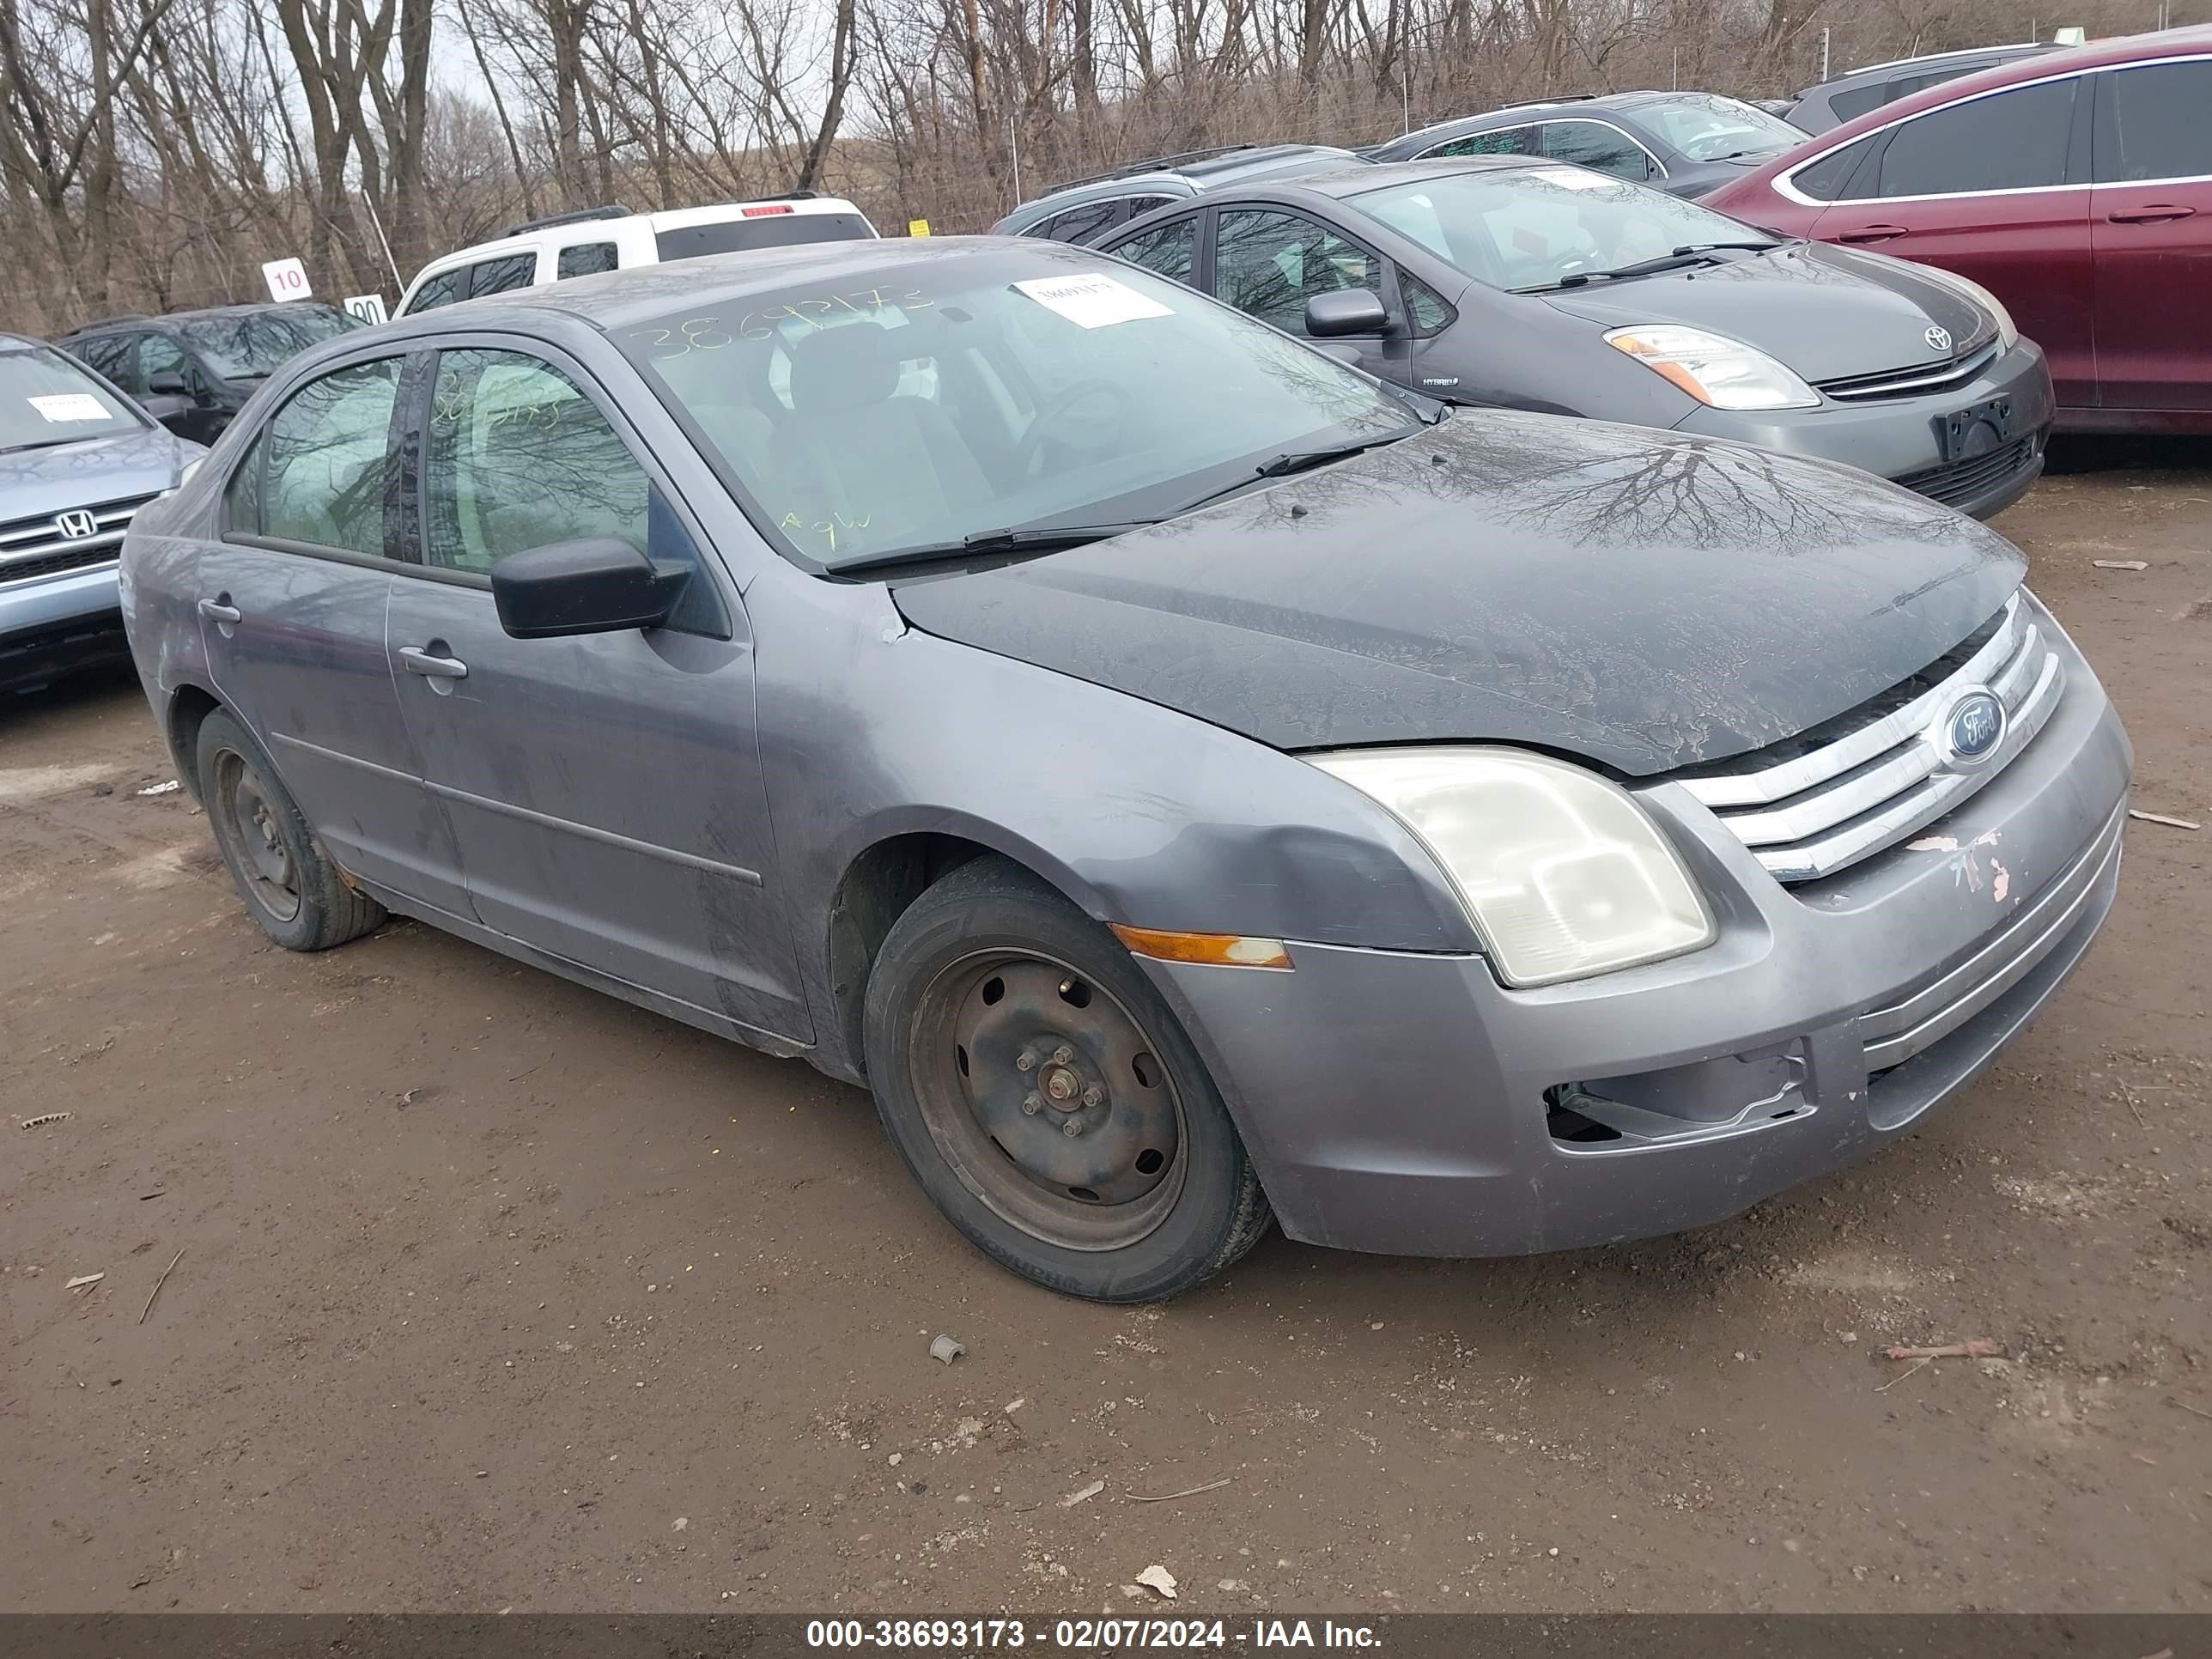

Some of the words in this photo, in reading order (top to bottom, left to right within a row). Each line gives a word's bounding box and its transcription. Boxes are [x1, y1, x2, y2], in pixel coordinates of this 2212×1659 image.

[274, 270, 301, 290] 10
[1423, 378, 1453, 386] HYBRID
[1962, 706, 1996, 747] Ford
